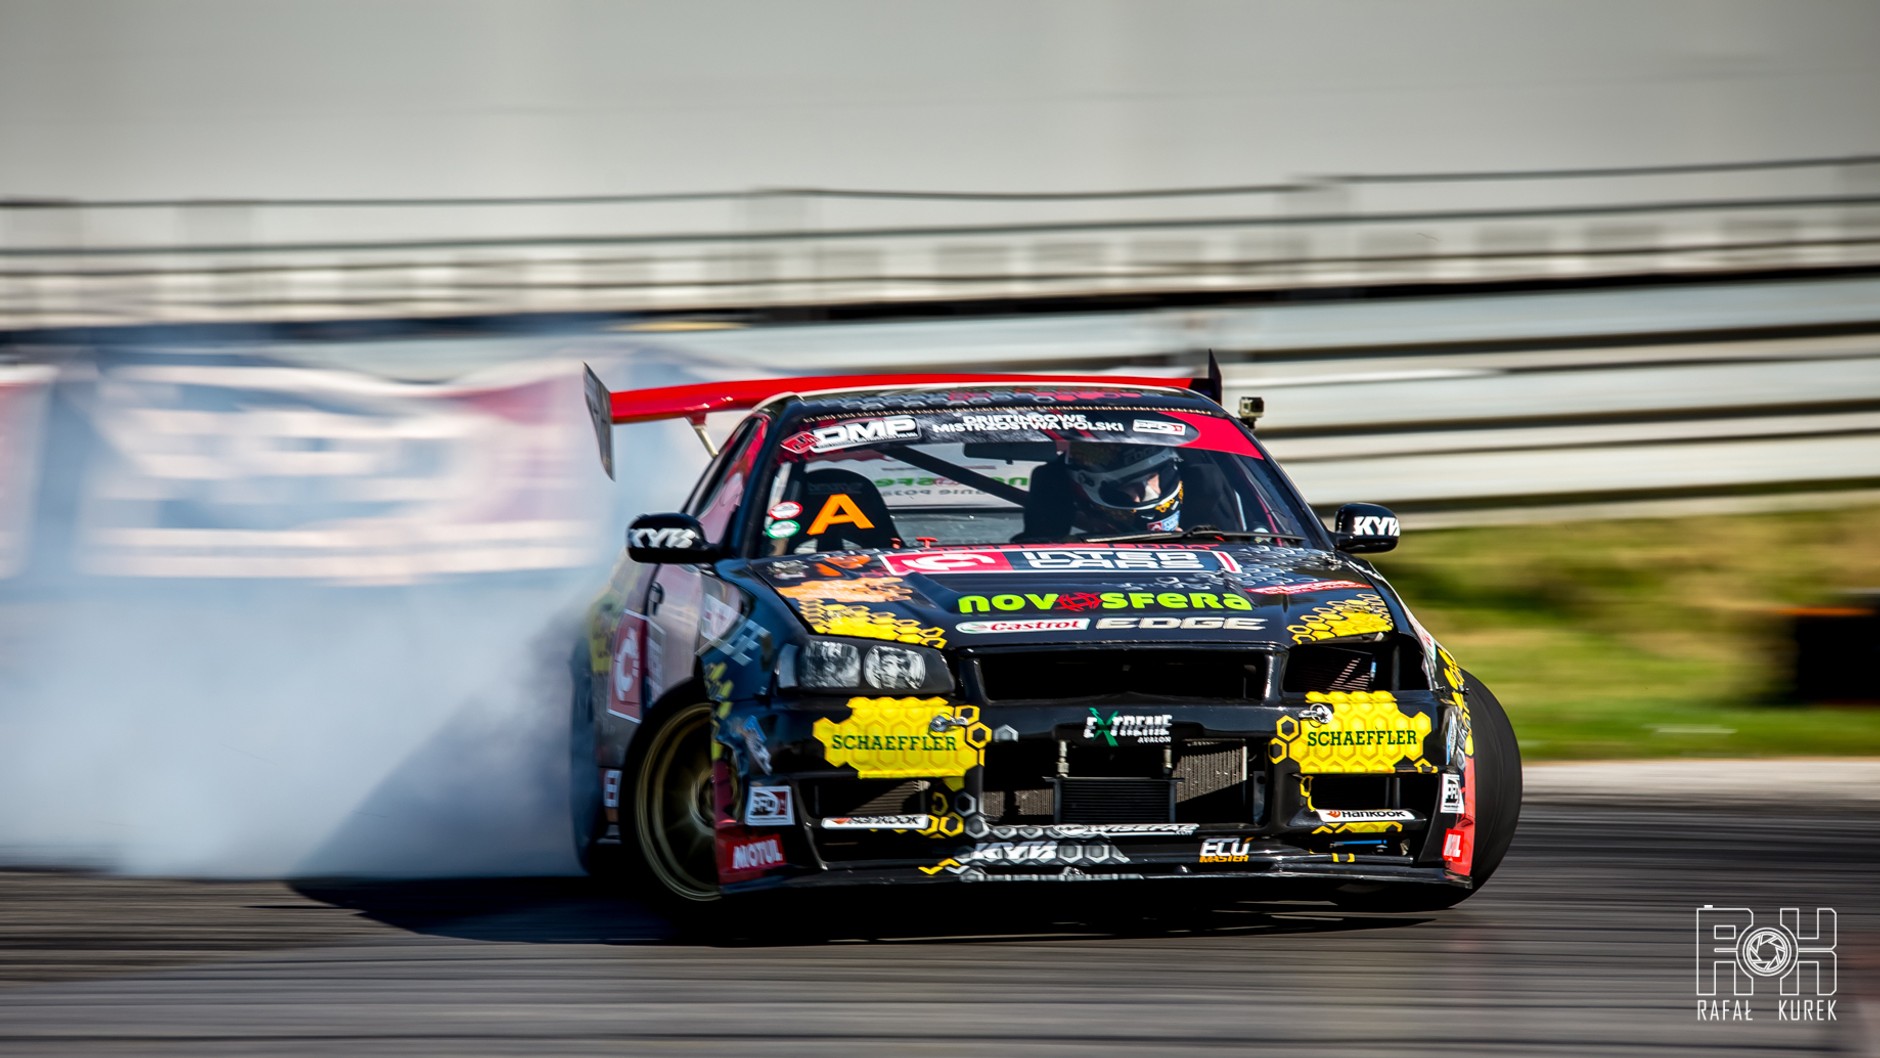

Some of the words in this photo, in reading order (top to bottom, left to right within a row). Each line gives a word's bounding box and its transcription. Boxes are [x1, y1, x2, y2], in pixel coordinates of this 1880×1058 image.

[963, 413, 1087, 425] DRIFTINGOWE
[1062, 421, 1125, 432] POLSKI
[813, 418, 917, 444] DMP
[806, 493, 876, 536] A
[1023, 550, 1198, 560] INTER
[1029, 559, 1205, 569] CARS
[991, 620, 1080, 631] Castrol
[1096, 617, 1268, 630] EDGE
[1083, 707, 1173, 746] EXTREME
[832, 734, 957, 751] SCHAEFFLER
[1308, 730, 1417, 747] SCHAEFFLER
[732, 839, 783, 869] MOTUL
[1200, 838, 1250, 856] ECU
[1199, 855, 1249, 863] MASTER
